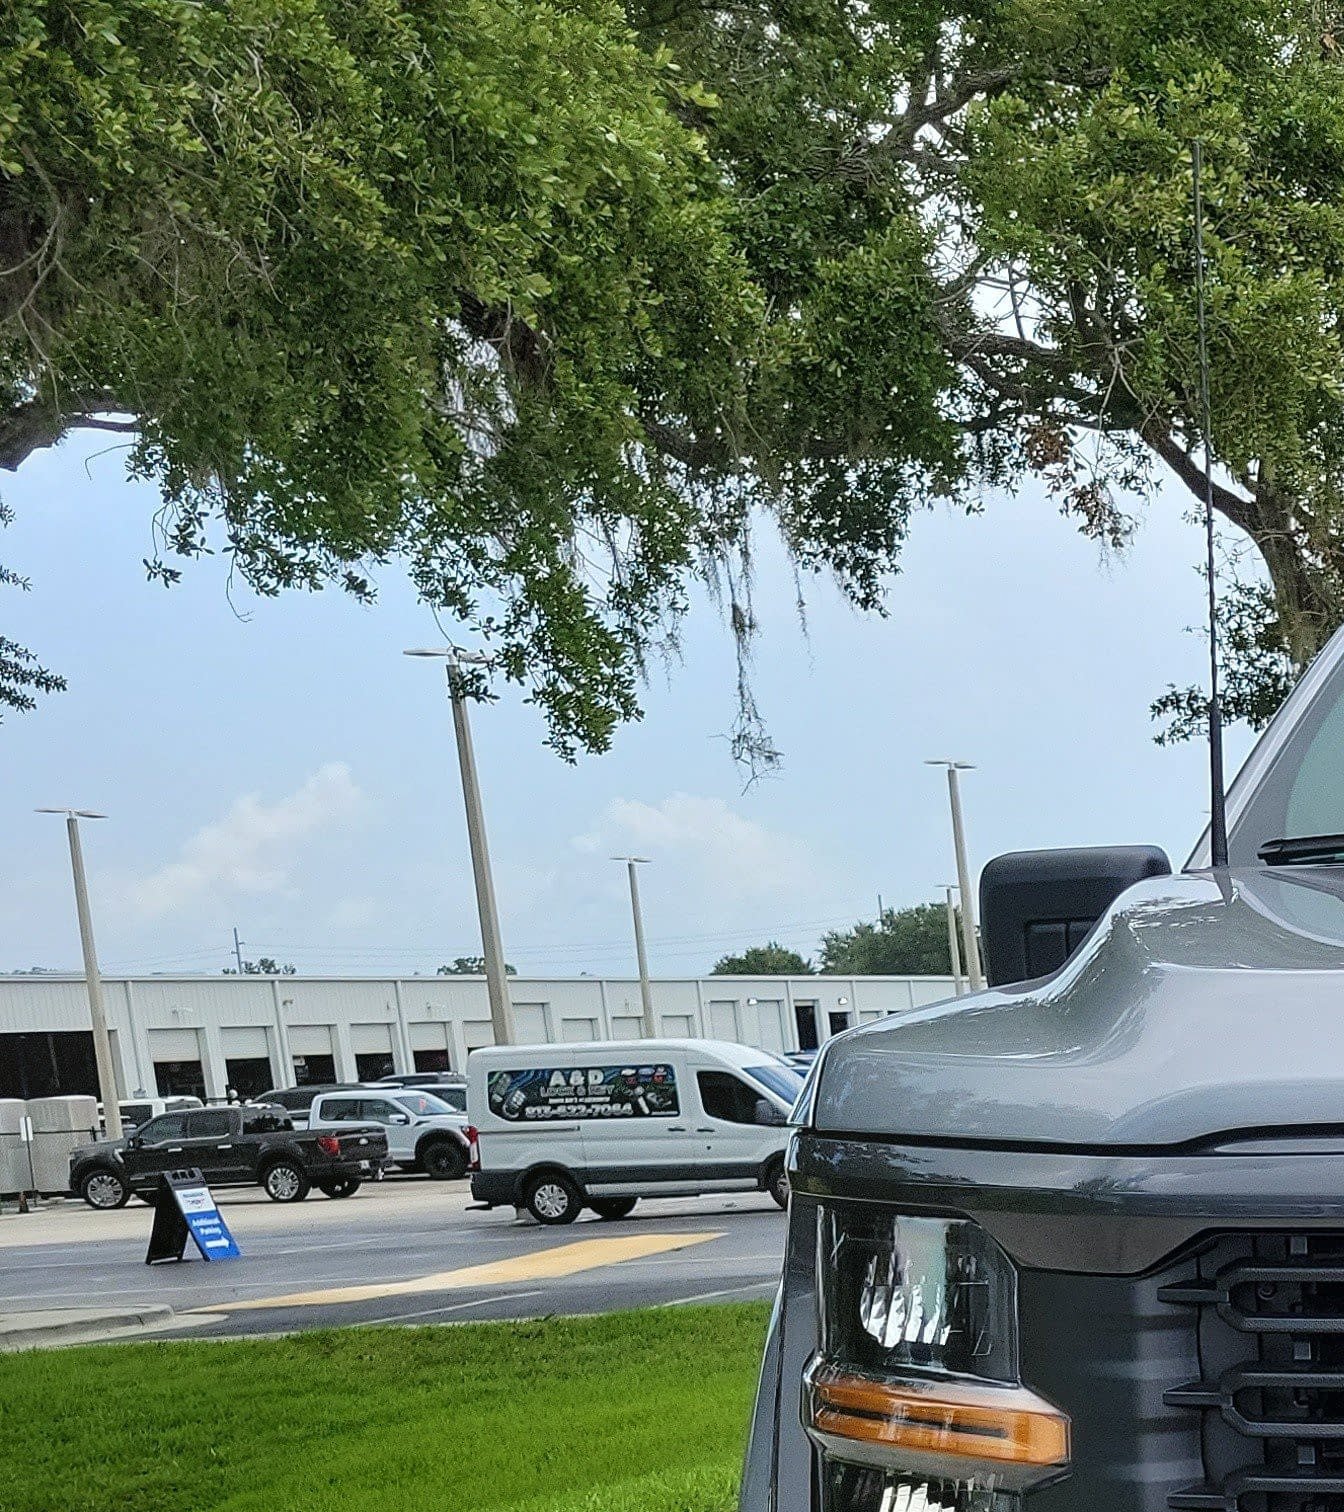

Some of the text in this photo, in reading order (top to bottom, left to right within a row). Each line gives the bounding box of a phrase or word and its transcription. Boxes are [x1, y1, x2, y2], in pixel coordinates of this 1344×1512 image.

[550, 1069, 604, 1087] A & D
